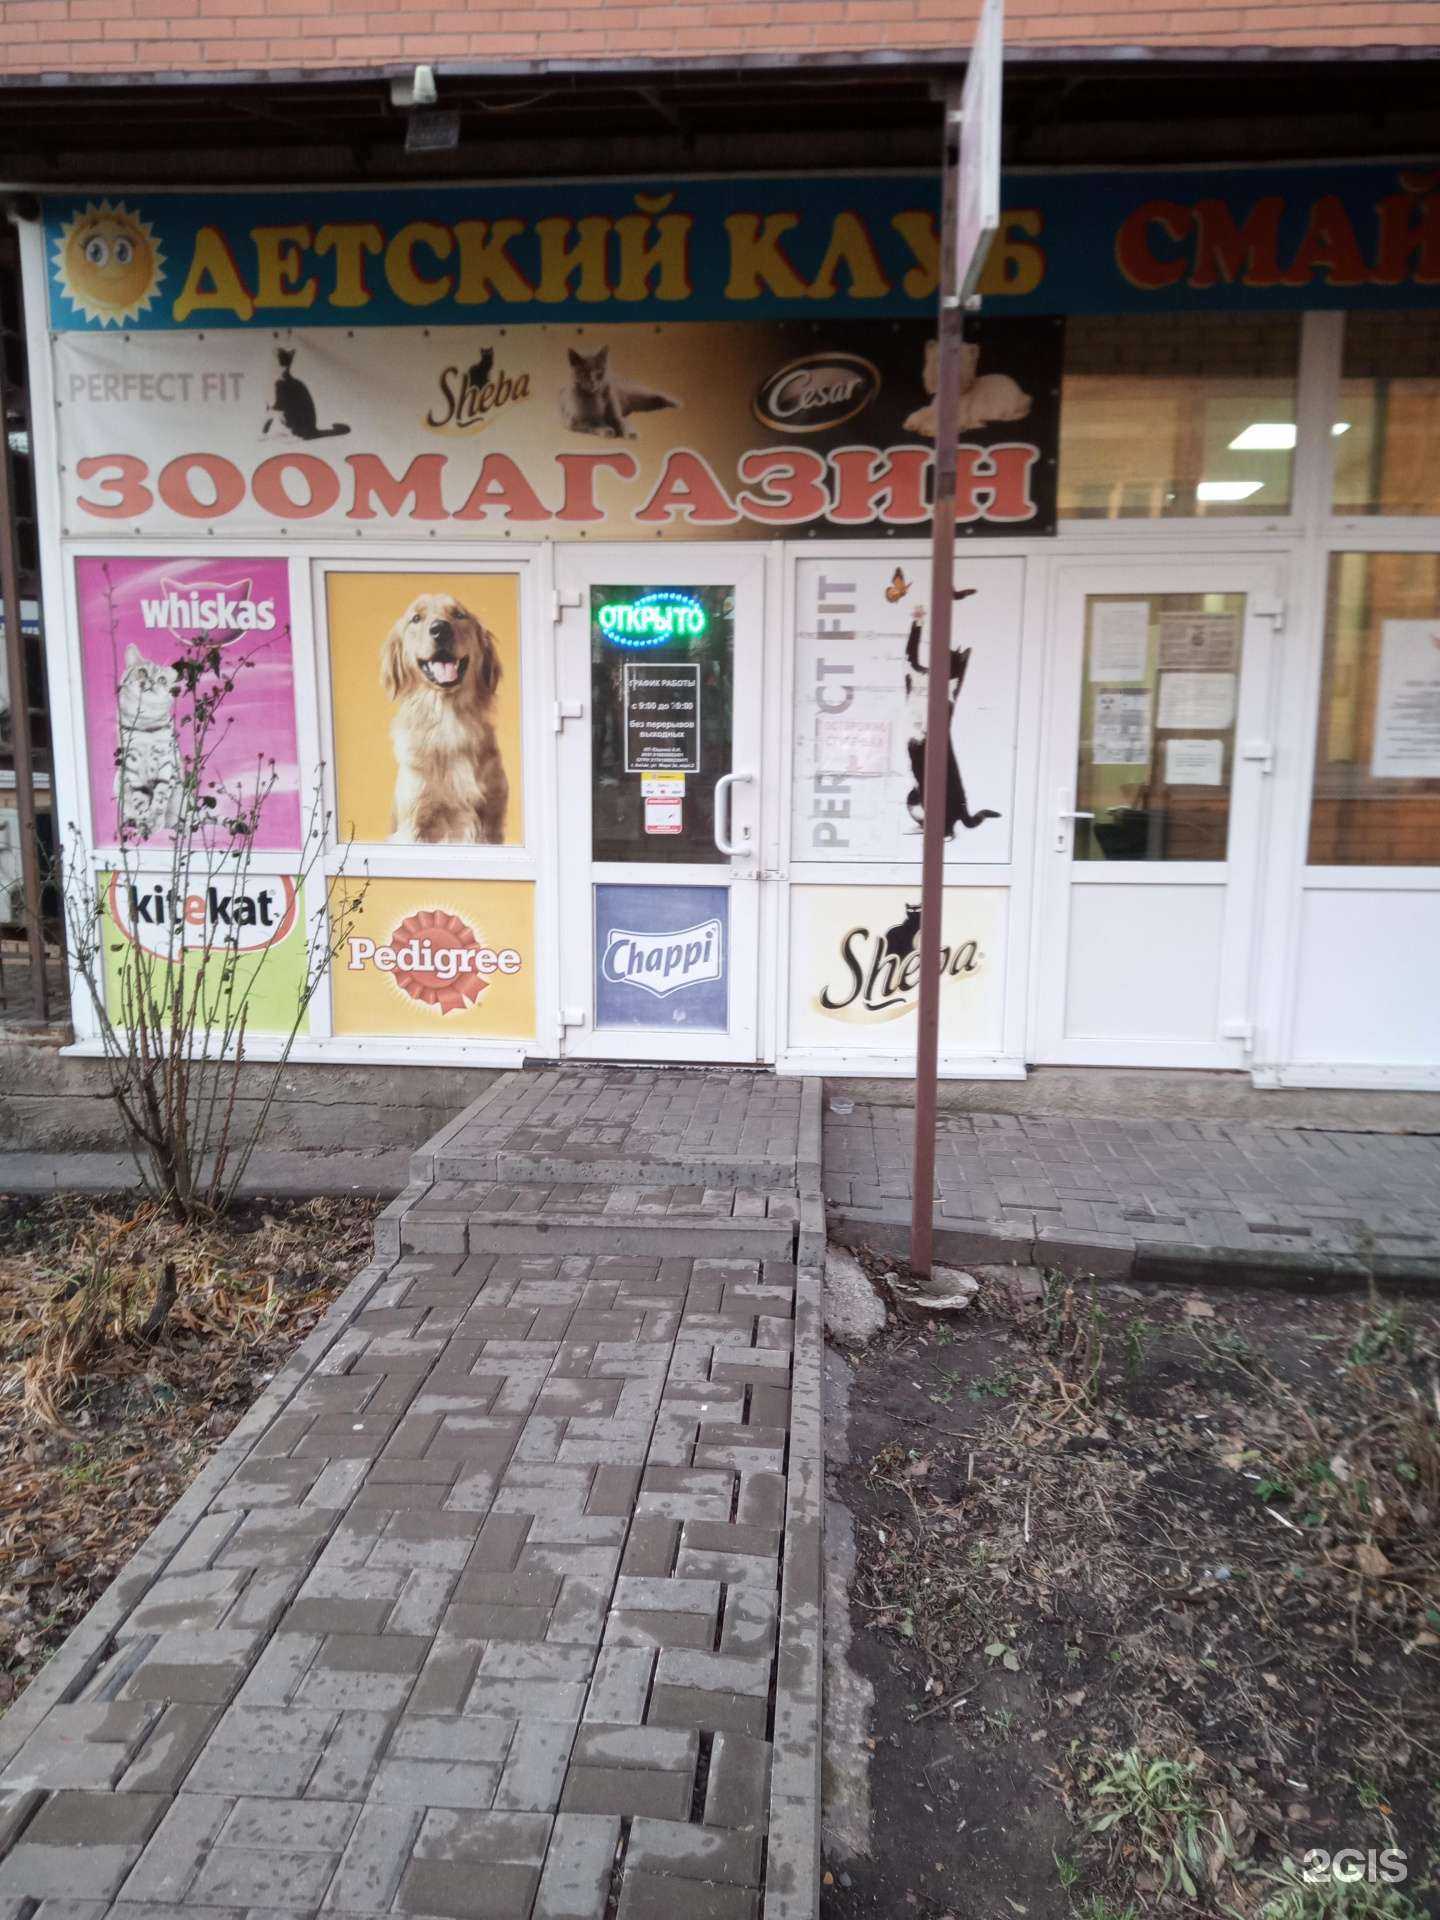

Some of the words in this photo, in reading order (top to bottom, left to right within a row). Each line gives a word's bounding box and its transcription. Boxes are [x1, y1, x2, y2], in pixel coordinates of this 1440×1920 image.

[172, 192, 694, 323] ДЕТСКИЙ
[724, 207, 1049, 300] КЛУБ
[68, 374, 194, 404] PERFECT
[201, 372, 245, 403] FIT
[427, 364, 531, 428] Sheba
[767, 369, 864, 417] Cesar
[74, 445, 1040, 525] ЗООМАГАЗИН
[141, 592, 276, 631] whiskas
[599, 604, 705, 634] ОТКРЫТО
[816, 575, 857, 641] FIT
[661, 679, 696, 688] РАБОТЫ
[812, 657, 855, 848] PERCT
[129, 885, 273, 927] kitekat
[347, 937, 522, 980] Pedigree
[603, 929, 714, 983] Chappi
